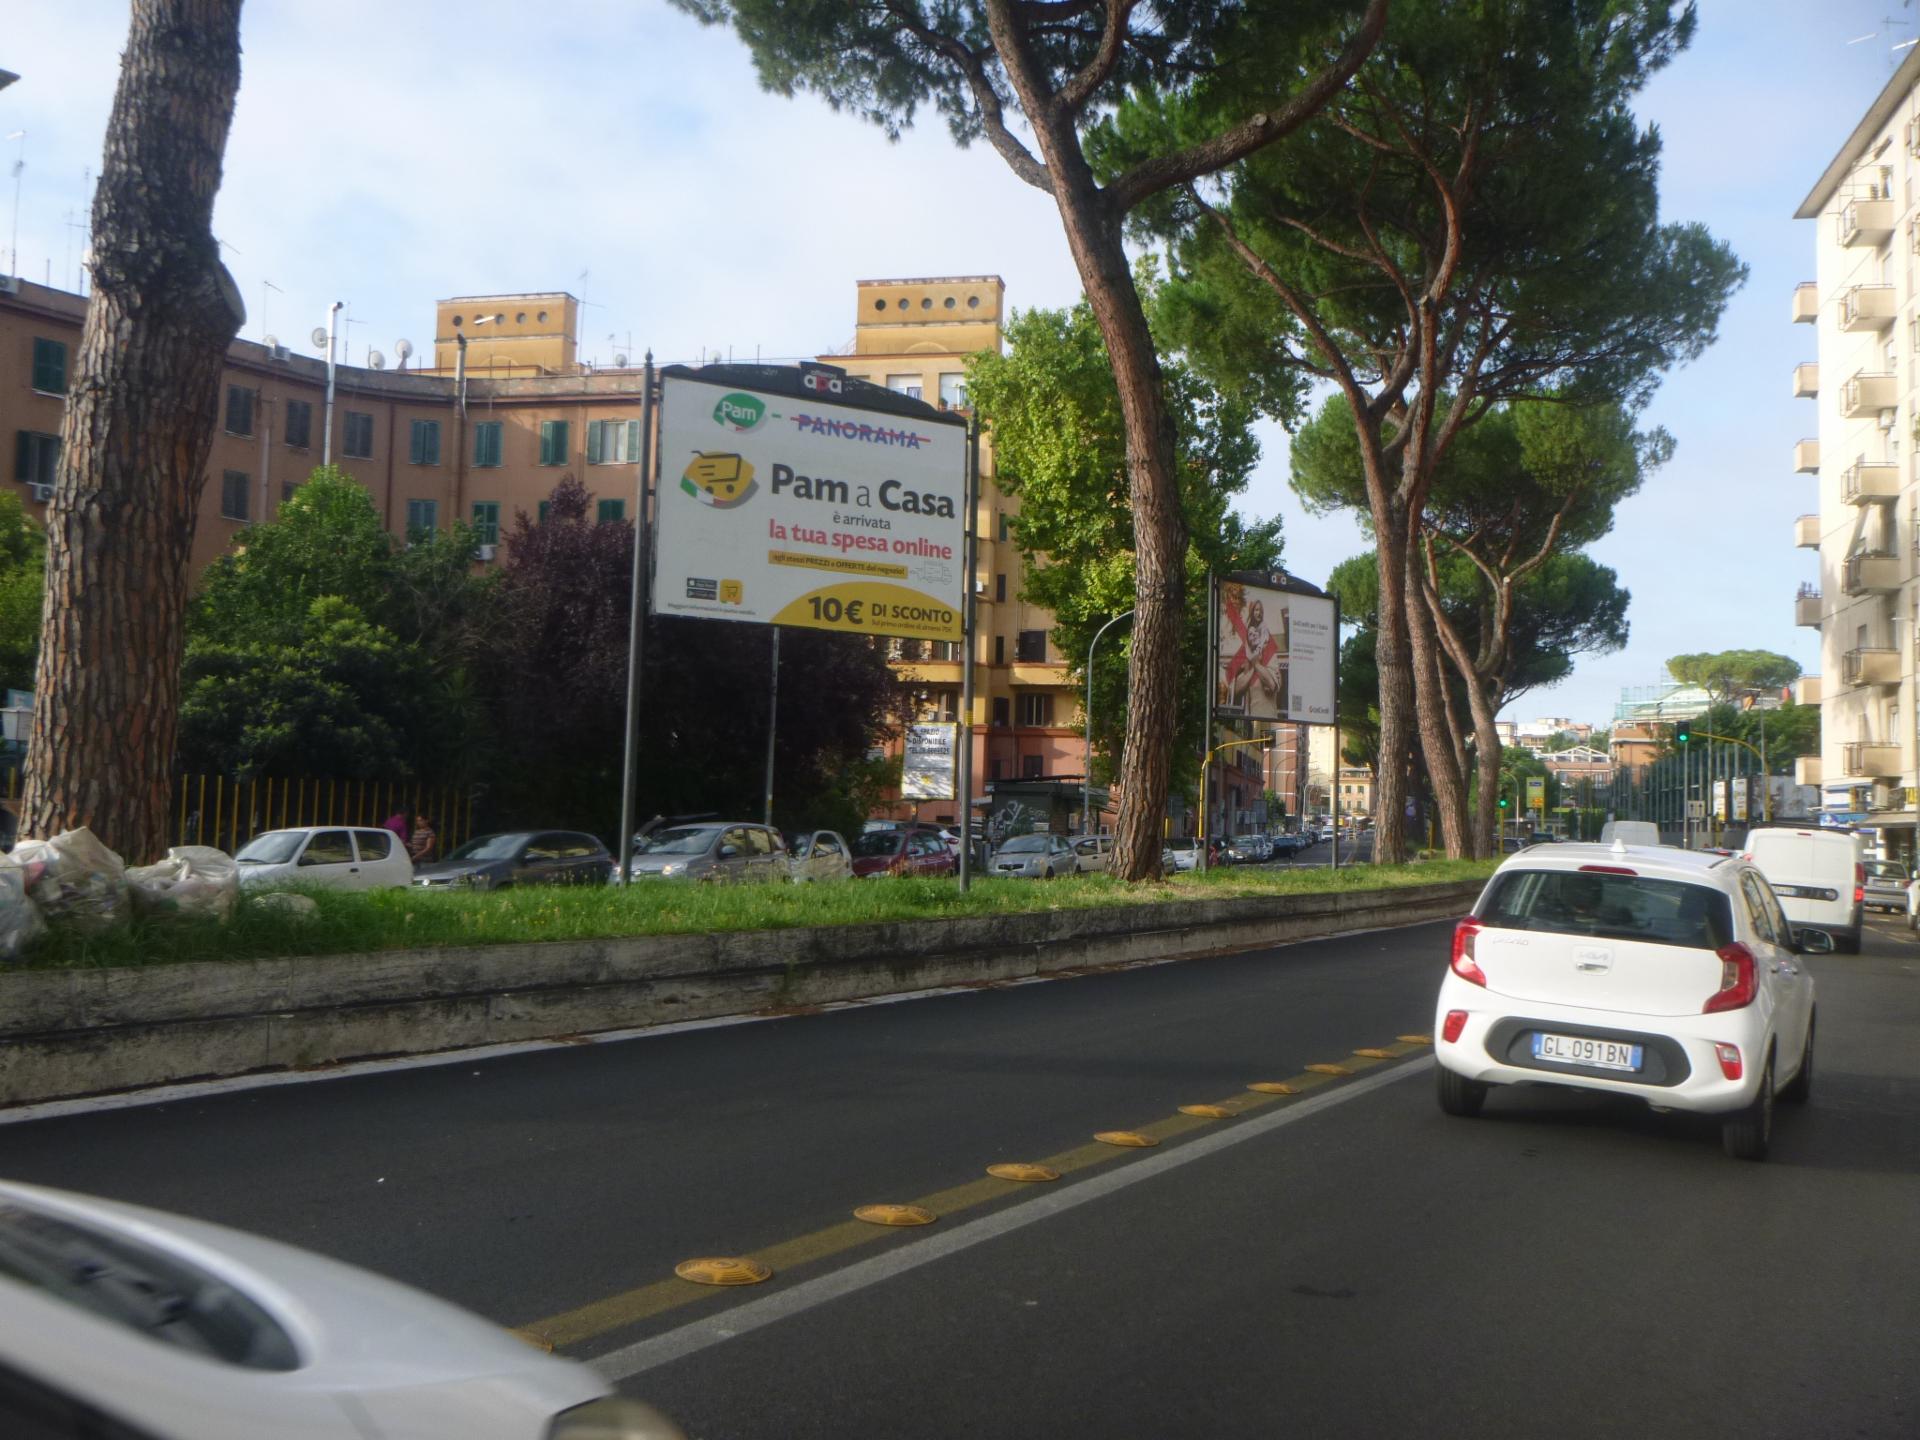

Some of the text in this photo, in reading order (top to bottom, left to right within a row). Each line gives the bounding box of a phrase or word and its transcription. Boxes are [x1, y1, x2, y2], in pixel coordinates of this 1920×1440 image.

[720, 401, 920, 449] Pam PANORAMA
[771, 463, 955, 519] Pam a Casa
[833, 511, 891, 530] è arrivata
[769, 518, 952, 560] la tua spesa online
[808, 596, 952, 624] 10€ DI SCONTO
[1544, 1036, 1629, 1064] GL 091BN
